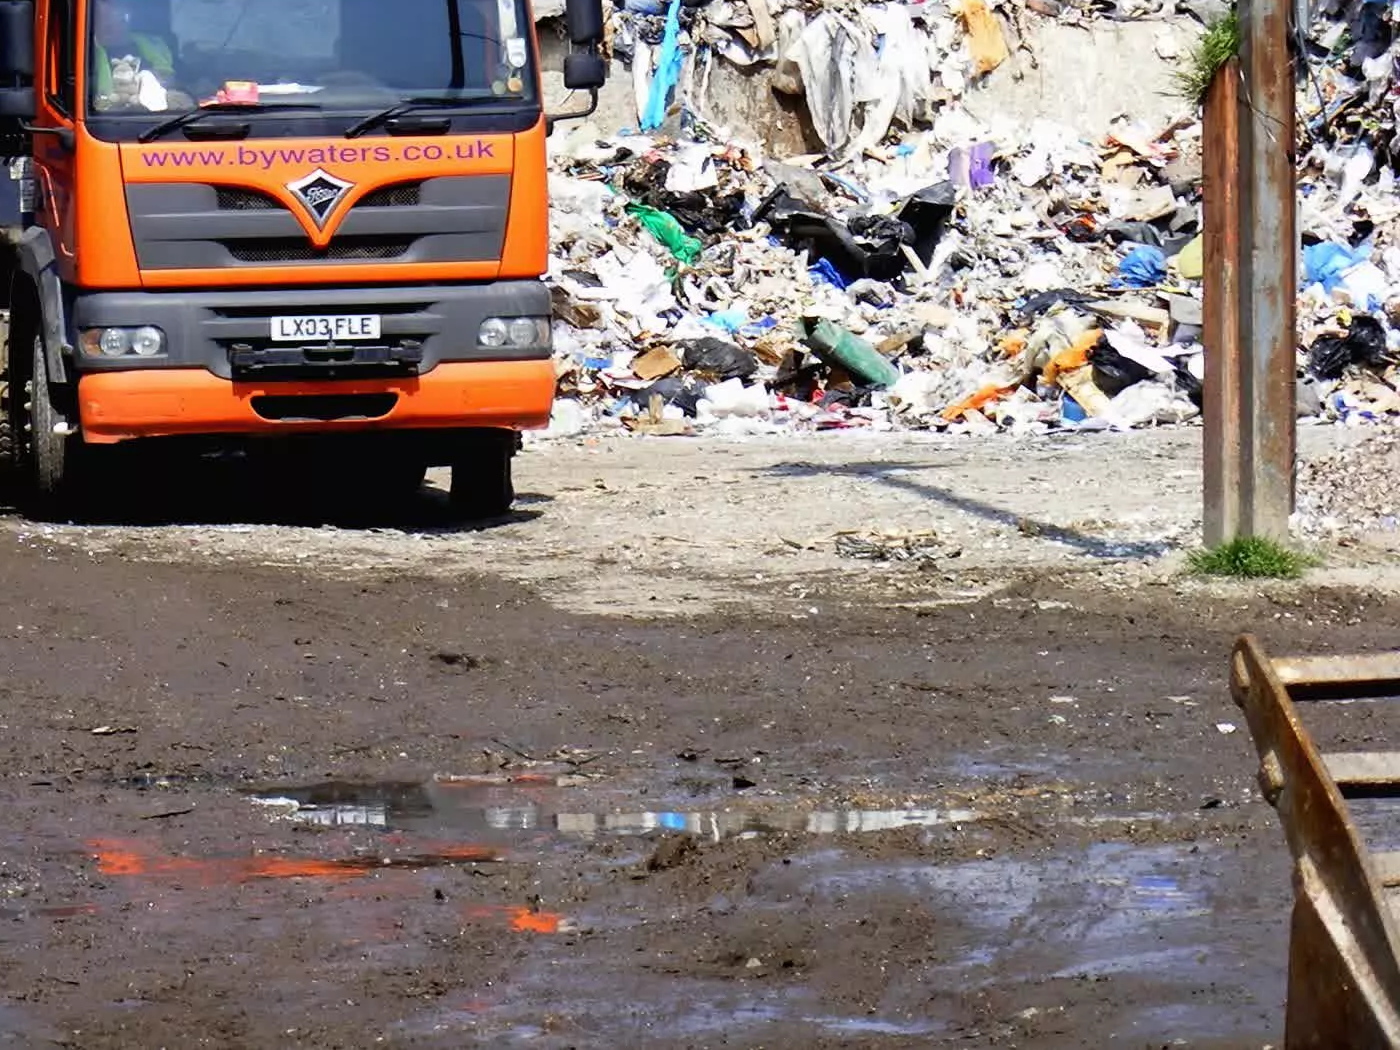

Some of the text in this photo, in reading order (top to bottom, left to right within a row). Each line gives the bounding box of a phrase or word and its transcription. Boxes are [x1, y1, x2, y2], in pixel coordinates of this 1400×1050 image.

[142, 139, 495, 170] www.bywaters.co.uk
[280, 317, 372, 337] LX03 FLE
